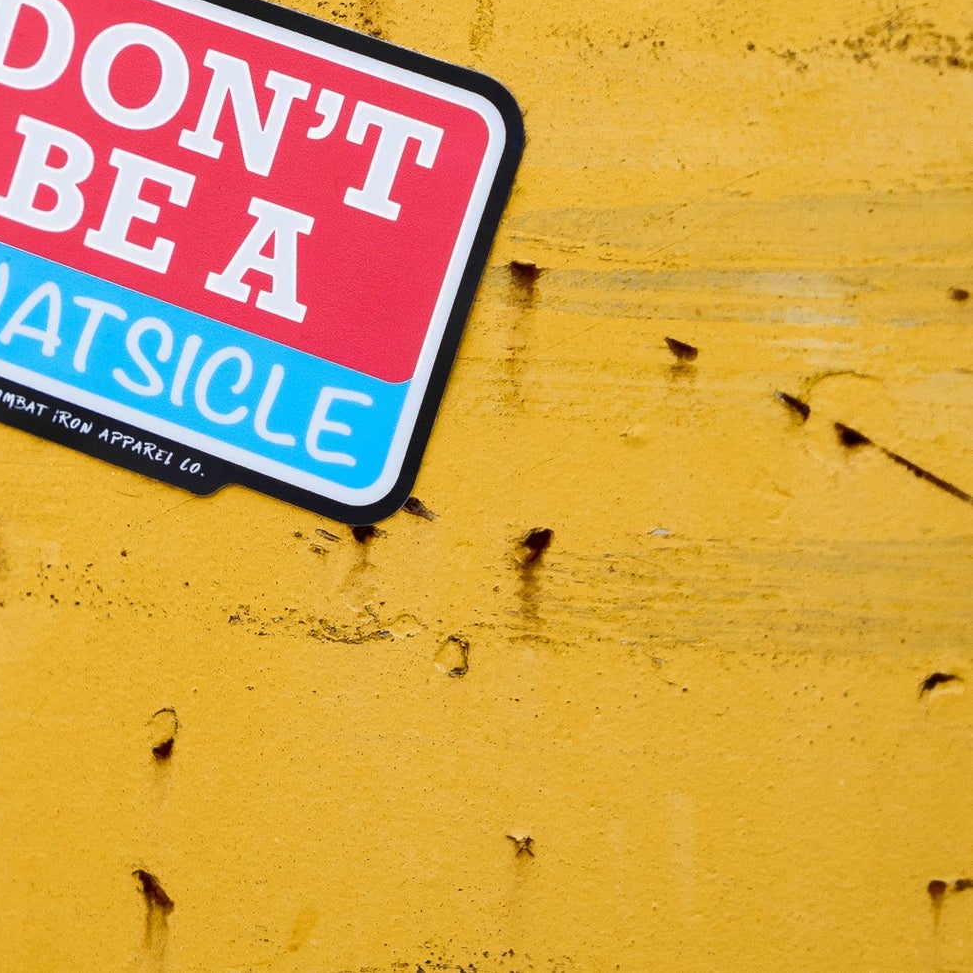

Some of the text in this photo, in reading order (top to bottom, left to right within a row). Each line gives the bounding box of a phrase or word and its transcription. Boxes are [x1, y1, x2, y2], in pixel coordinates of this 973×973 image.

[205, 198, 315, 324] A
[98, 431, 174, 466] APPAREL
[179, 457, 205, 477] CO.
